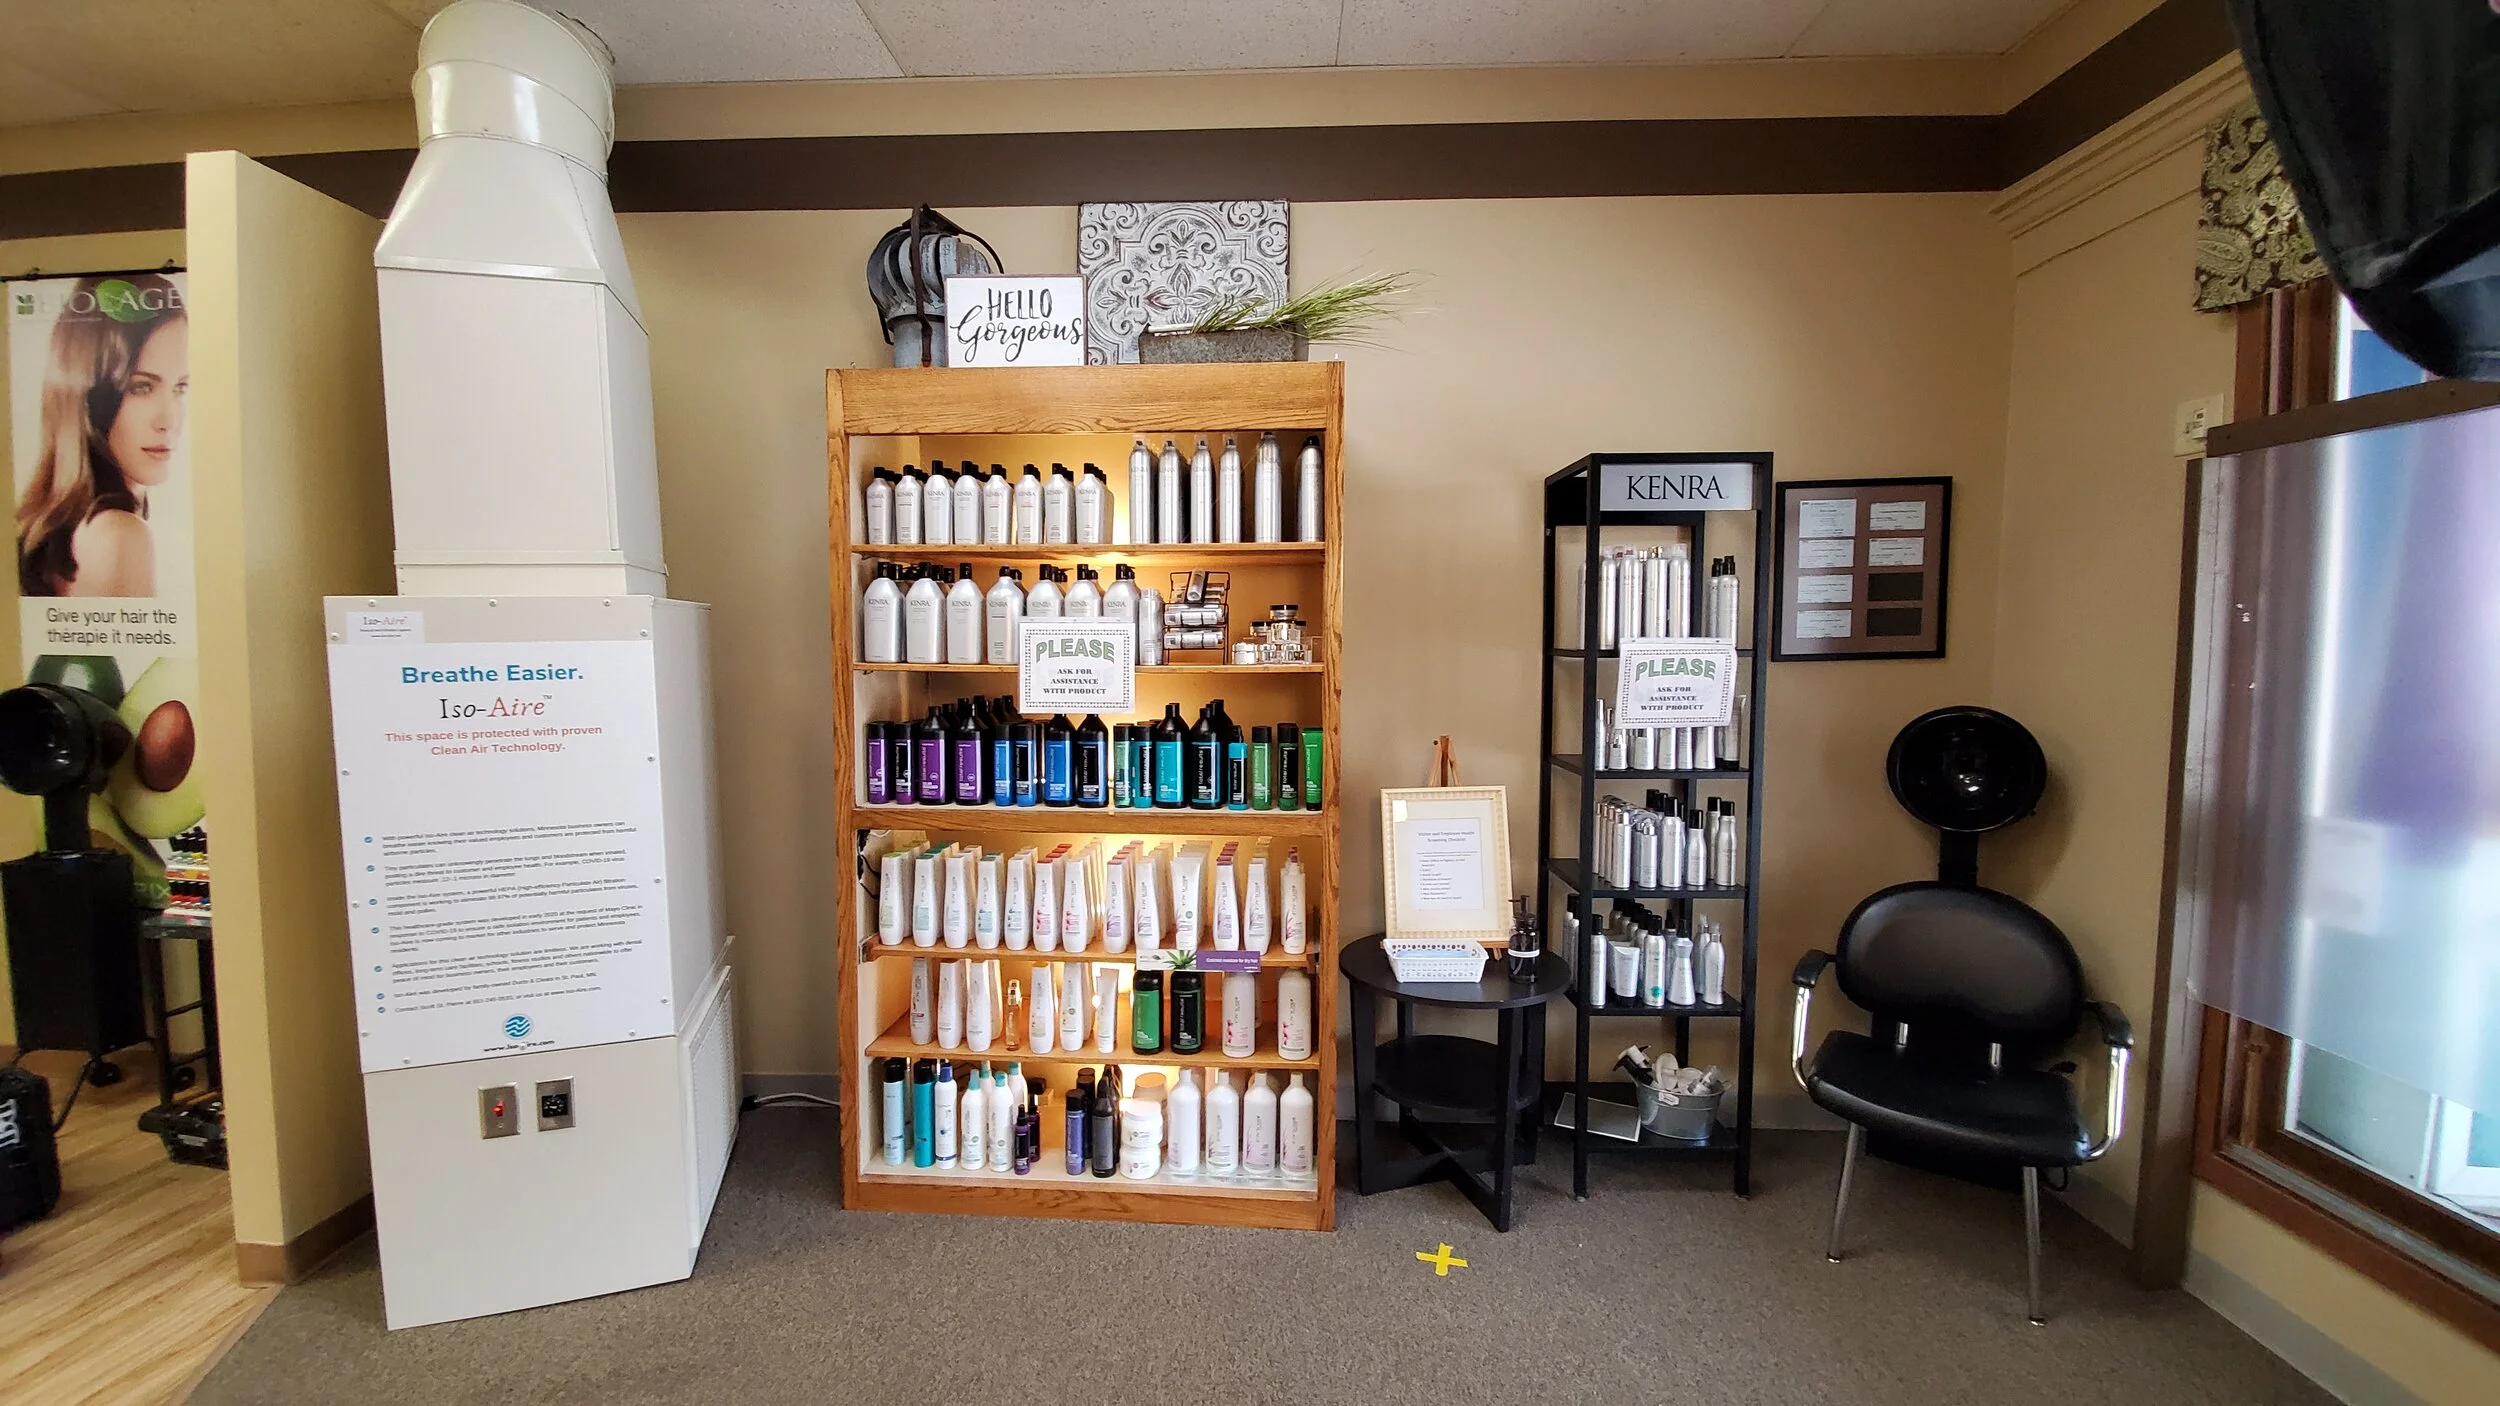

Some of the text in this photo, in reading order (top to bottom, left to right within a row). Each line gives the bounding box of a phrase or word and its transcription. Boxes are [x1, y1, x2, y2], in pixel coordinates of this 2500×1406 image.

[987, 287, 1053, 321] HELLO
[950, 304, 1083, 363] Gorgeous
[1627, 475, 1724, 500] KENRA
[46, 607, 177, 627] Give your hair the
[112, 628, 121, 643] it
[126, 630, 177, 645] needs.
[1035, 637, 1115, 665] PLEASE
[401, 663, 584, 684] Breathe Easier.
[1635, 657, 1716, 683] PLEASE
[385, 725, 602, 744] This space is protected with proven
[431, 741, 566, 756] Clean Air Technology.
